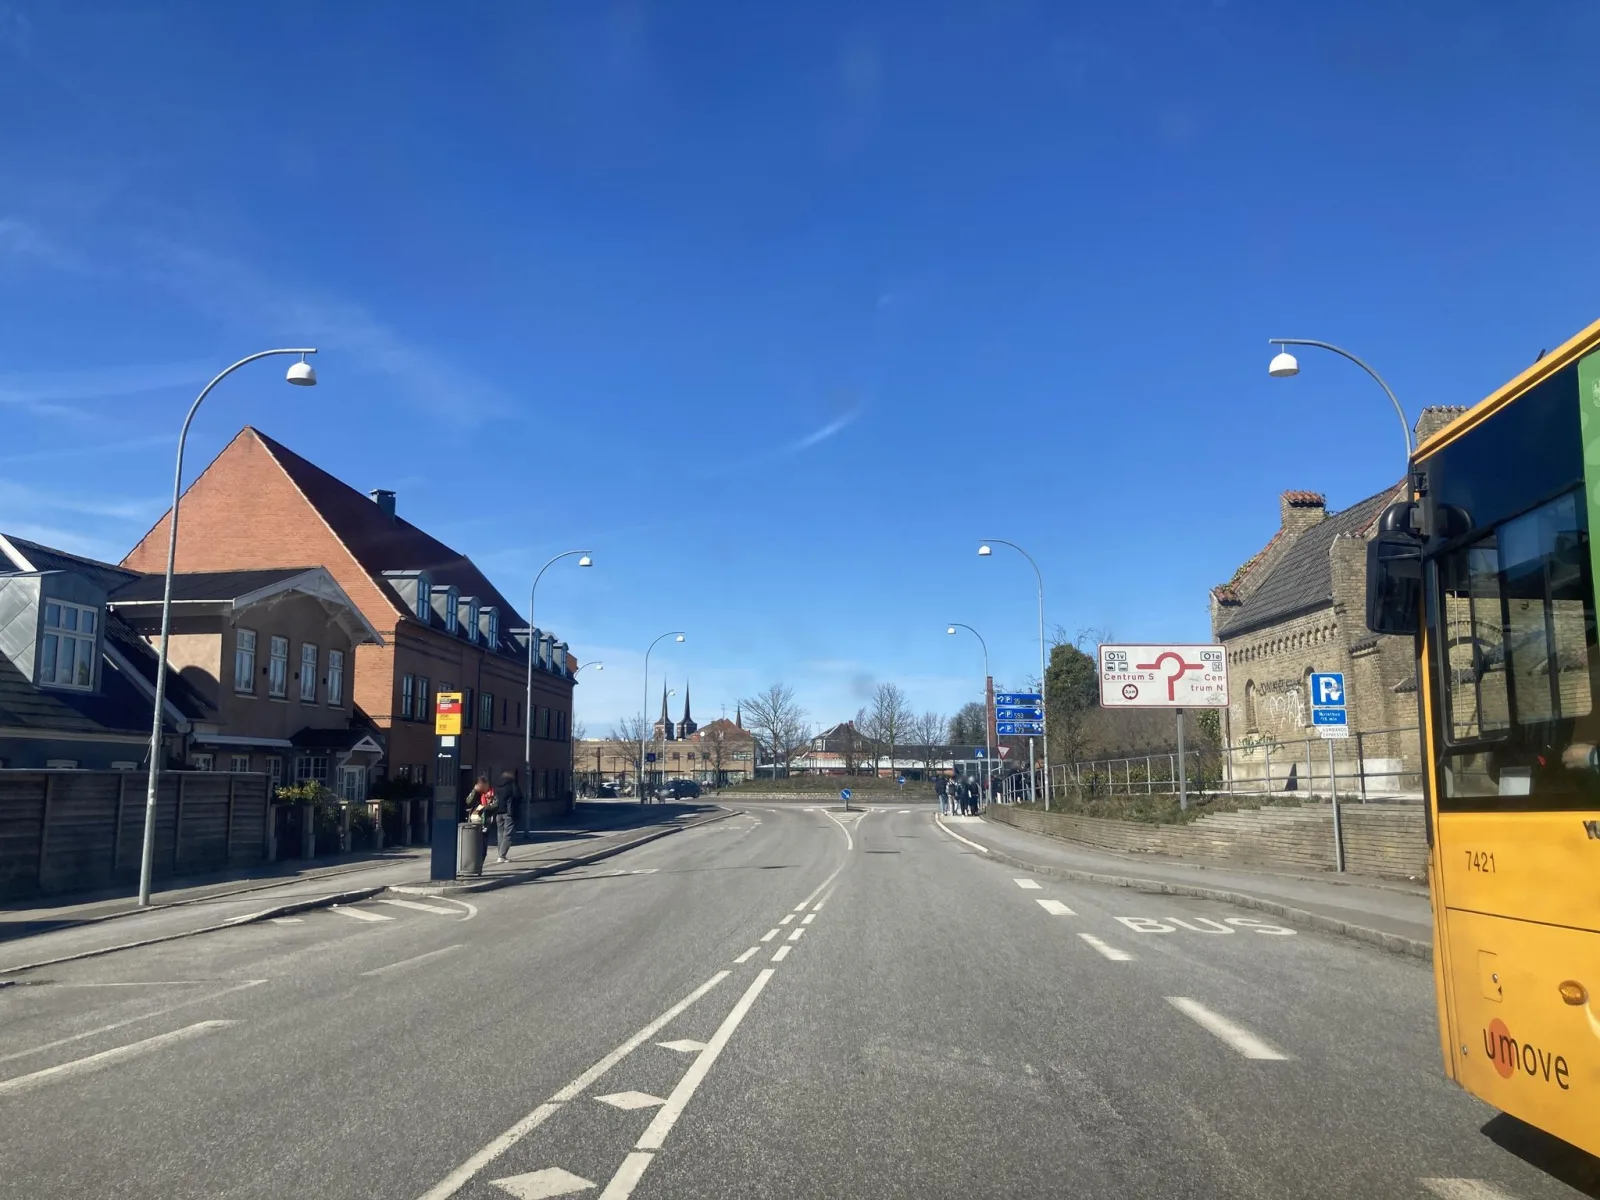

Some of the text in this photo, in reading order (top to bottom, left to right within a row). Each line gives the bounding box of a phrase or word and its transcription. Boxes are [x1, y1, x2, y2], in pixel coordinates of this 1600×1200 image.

[1104, 673, 1154, 681] Centrum S
[1465, 850, 1496, 873] 7421
[1113, 916, 1298, 935] BUS
[1482, 1027, 1570, 1090] umove
